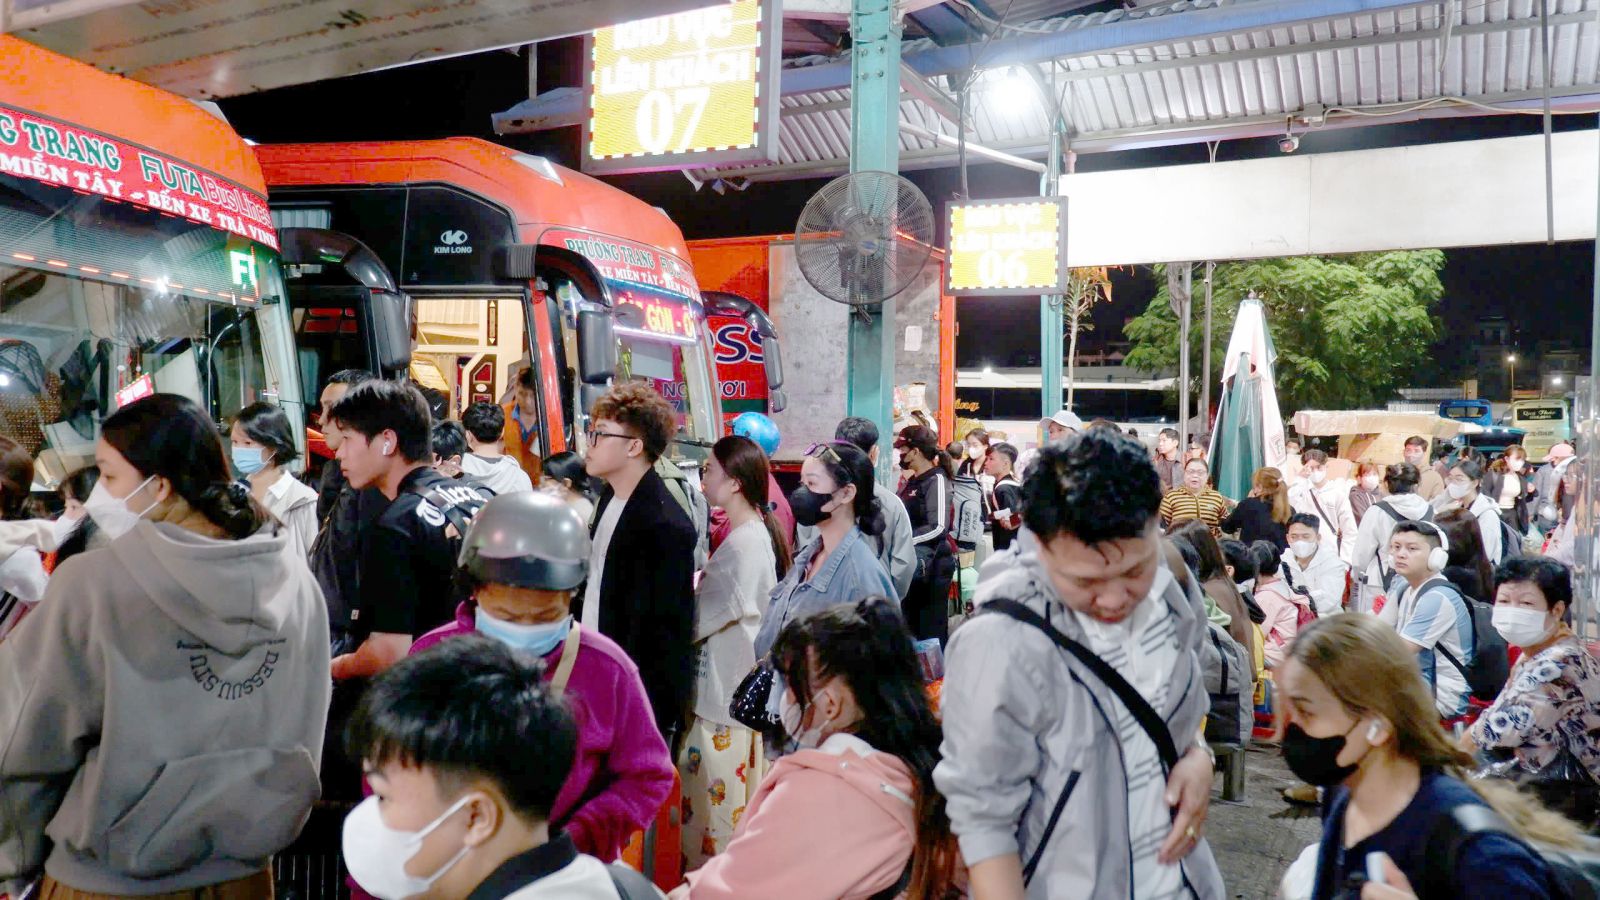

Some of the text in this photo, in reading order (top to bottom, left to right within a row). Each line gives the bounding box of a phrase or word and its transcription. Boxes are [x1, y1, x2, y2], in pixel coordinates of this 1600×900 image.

[601, 56, 650, 94] LÊN
[636, 88, 711, 152] 07
[21, 119, 121, 172] TRANG
[73, 171, 123, 197] TÂY
[146, 189, 186, 216] BẾN
[187, 203, 213, 223] XE
[216, 213, 248, 236] TRÀ
[247, 225, 279, 251] VINH
[434, 246, 473, 254] KIM LONG
[564, 235, 655, 269] PHƯƠNG TRANG
[977, 250, 1028, 287] 06
